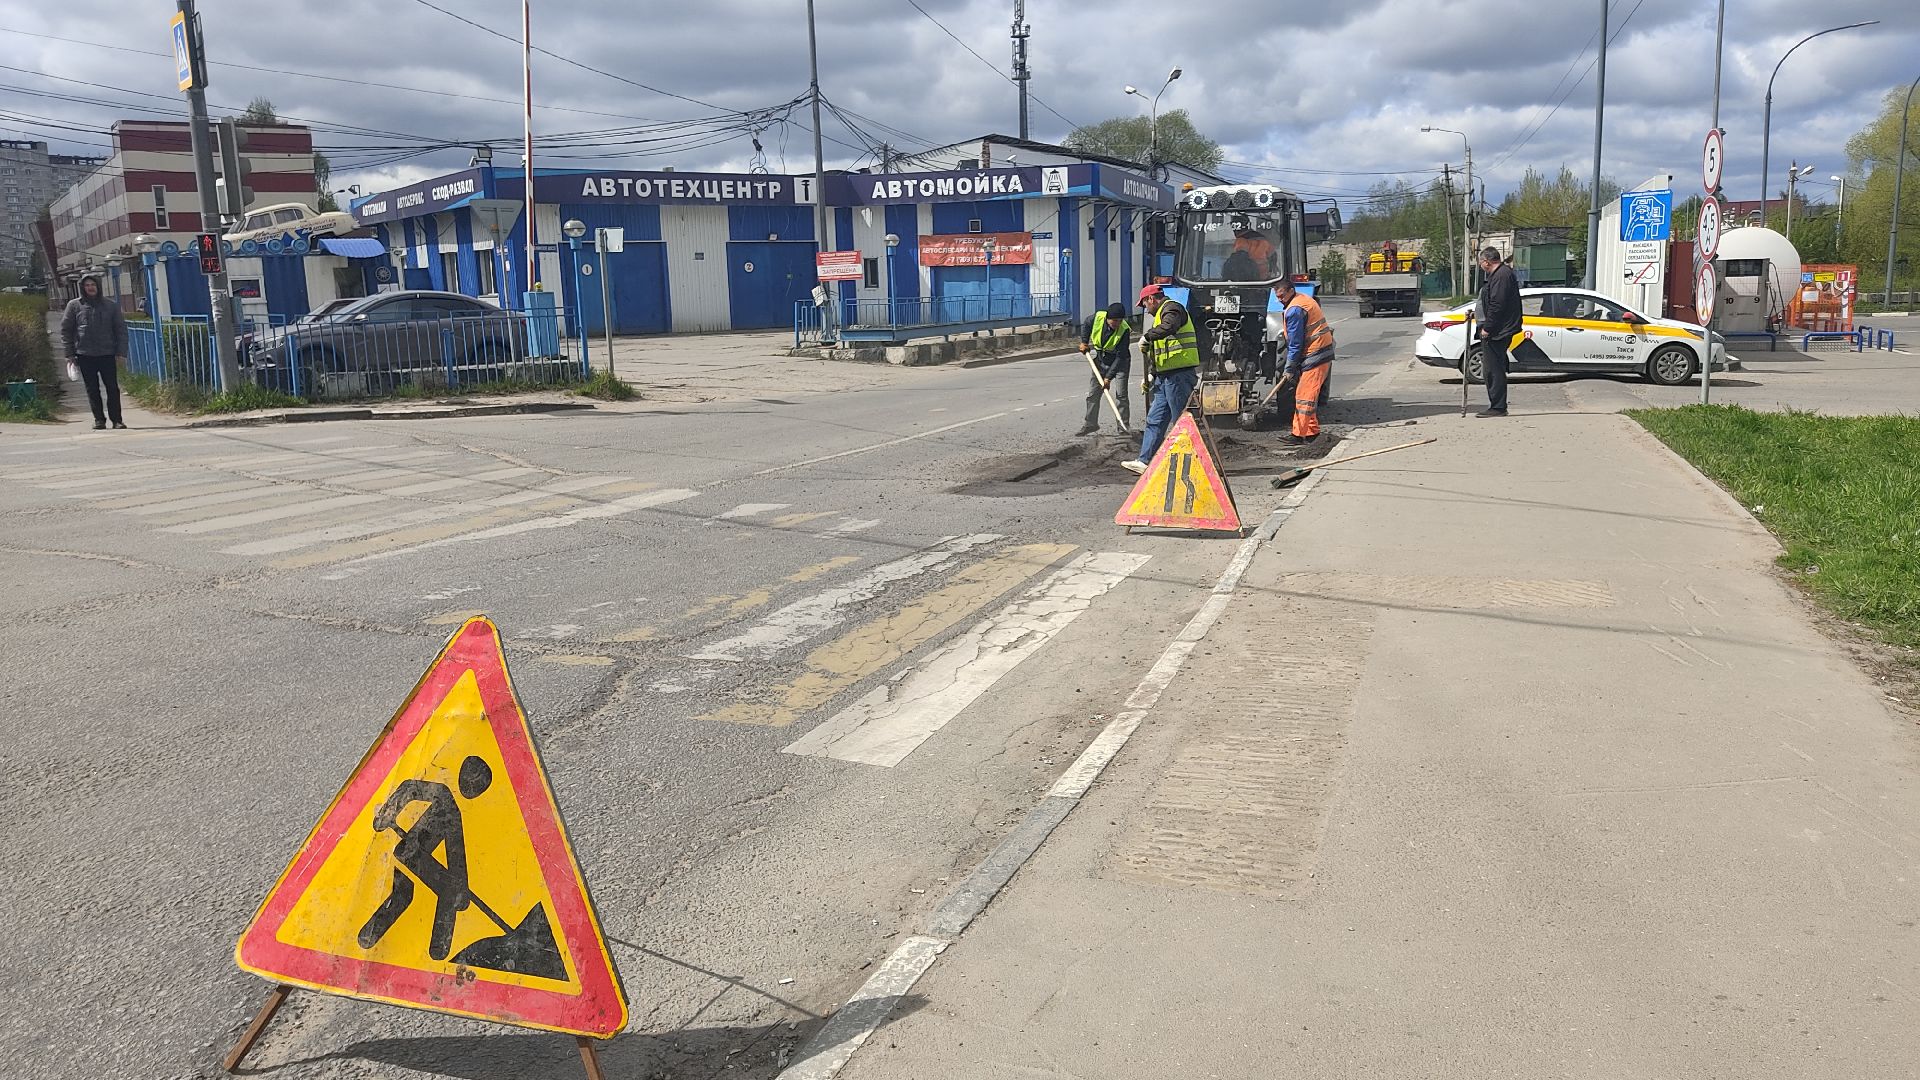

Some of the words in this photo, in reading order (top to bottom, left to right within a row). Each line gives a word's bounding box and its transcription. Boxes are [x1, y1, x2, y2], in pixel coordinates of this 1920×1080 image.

[1709, 147, 1715, 172] 5
[397, 191, 425, 210] АВТОСЕРВИС
[432, 179, 475, 201] СХОД-РАЗВАЛ
[581, 177, 782, 202] АВТОТЕХЦЕНТР
[871, 172, 1024, 199] АВТОМОЙКА
[1123, 178, 1159, 202] АВТОЗАПЧАСТИ
[1702, 212, 1715, 235] 4,5
[921, 246, 969, 254] АВТОСЛЕСАРИ
[822, 267, 857, 275] ЗАПРЕЩЕНА
[1754, 296, 1760, 304] 9
[1547, 330, 1557, 338] 121
[1600, 334, 1624, 343] Яндекс
